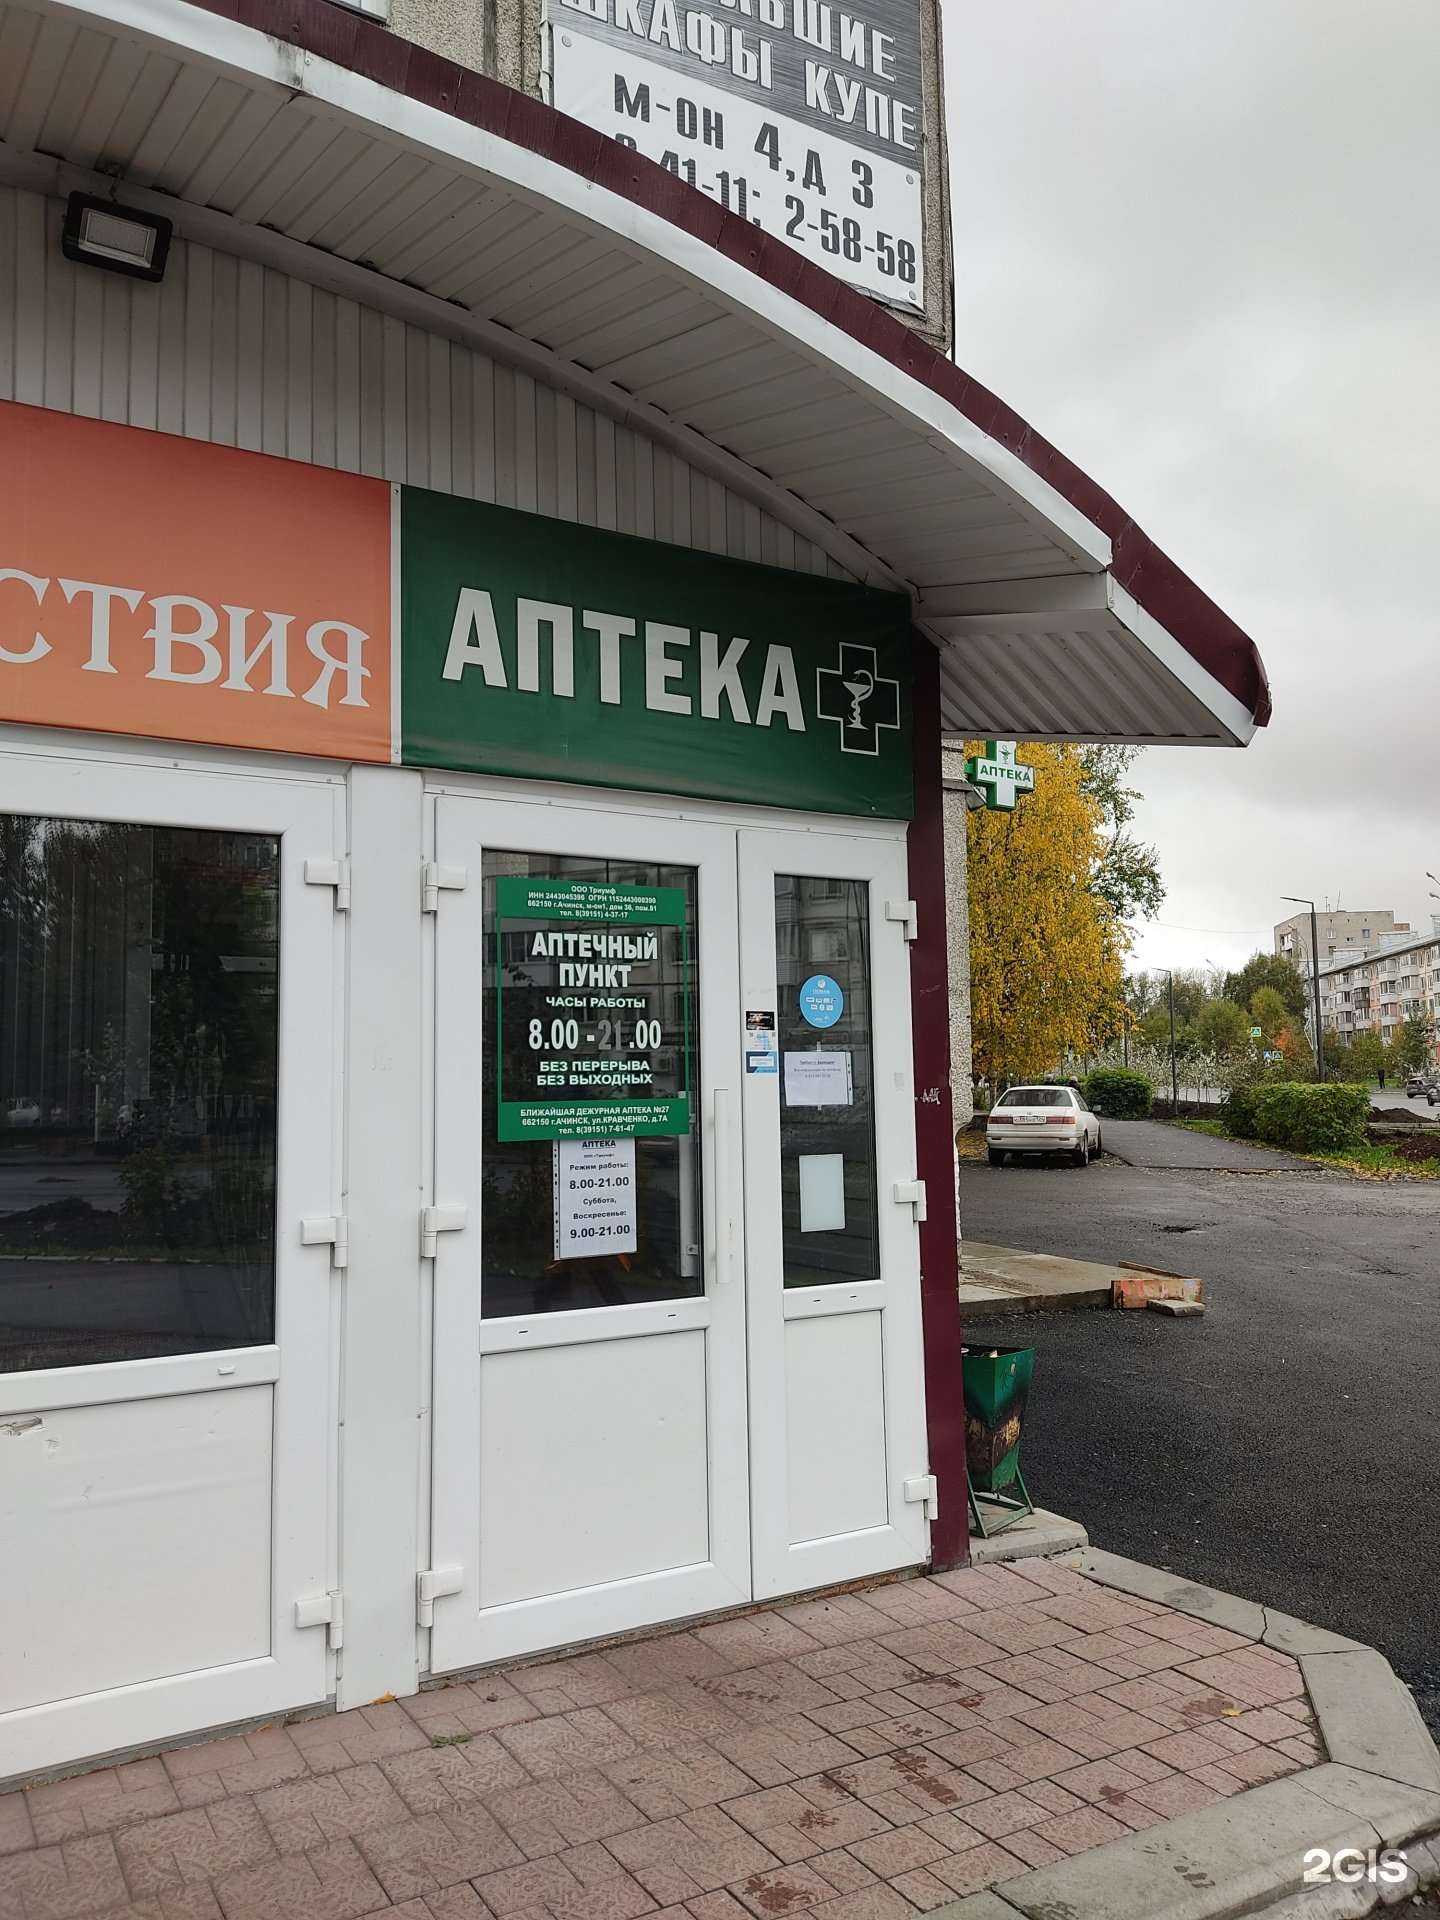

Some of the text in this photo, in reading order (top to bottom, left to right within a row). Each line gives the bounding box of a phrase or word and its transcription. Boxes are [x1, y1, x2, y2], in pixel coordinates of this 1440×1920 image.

[719, 0, 897, 83] ЬШИЕ
[804, 59, 917, 151] КУПЕ
[615, 73, 724, 150] М-ОН
[851, 159, 873, 209] 3
[785, 194, 915, 284] 2-58-58
[442, 587, 806, 731] АПТЕКА
[980, 765, 1031, 782] АПТЕКА
[528, 891, 544, 899] ИНН
[588, 894, 607, 902] ОГРН
[571, 885, 617, 895] ООО Триумф
[531, 931, 658, 960] АПТЕЧНЫЙ
[559, 963, 632, 988] ПУНКТ
[545, 996, 646, 1009] ЧАСЫ РАБОТЫ
[528, 1018, 579, 1050] 8.00
[540, 1060, 650, 1072] БЕЗ ПЕРЕРЫВА
[536, 1073, 653, 1086] БЕЗ ВЫХОДНЫХ
[520, 1107, 575, 1117] БЛИЖАЙШАЯ
[576, 1106, 621, 1116] ДЕЖУРНАЯ
[622, 1106, 652, 1114] АПТЕКА
[522, 1118, 550, 1126] 662150
[582, 1140, 616, 1149] АПТЕКА
[598, 1162, 630, 1171] работы:
[569, 1176, 630, 1190] 8.00-21.00
[582, 1197, 617, 1206] Суббота,
[569, 1224, 630, 1239] 9.00-21.00
